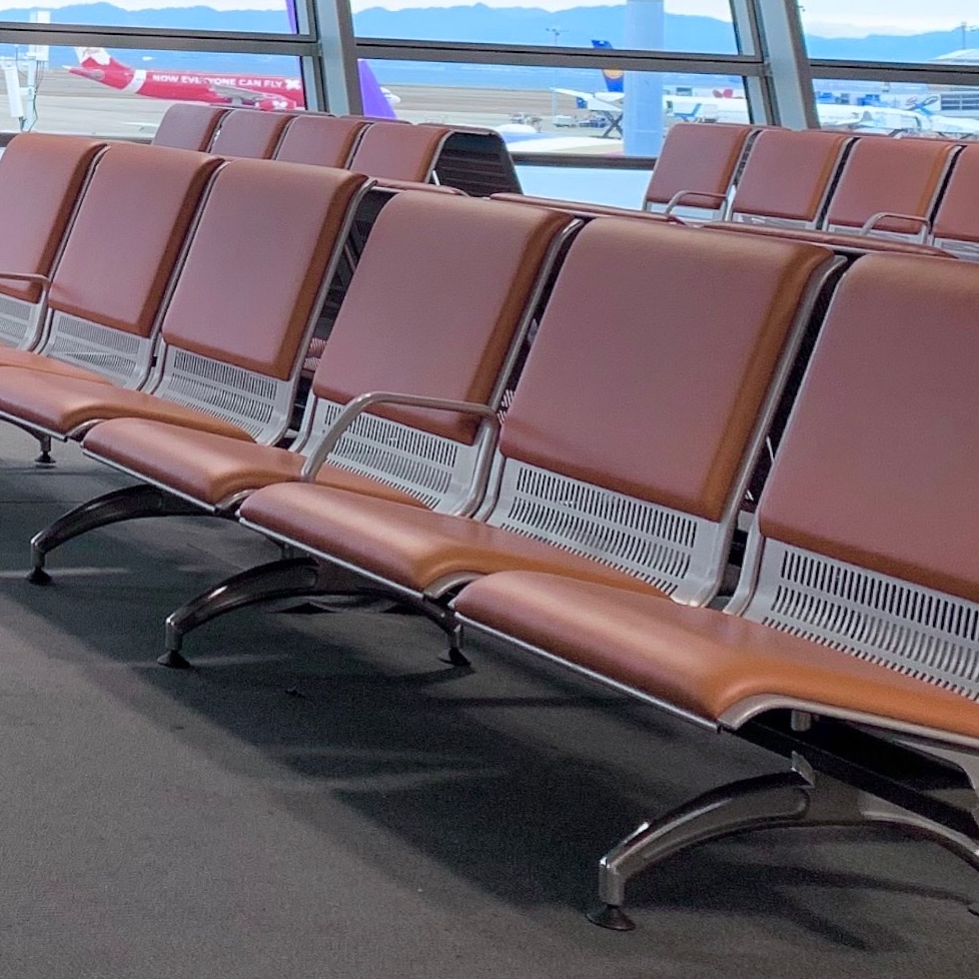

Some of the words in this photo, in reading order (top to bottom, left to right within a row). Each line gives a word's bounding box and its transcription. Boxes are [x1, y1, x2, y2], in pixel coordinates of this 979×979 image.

[152, 75, 180, 83] NOW
[180, 76, 237, 86] EVEYONE
[238, 79, 262, 87] CAN
[263, 80, 283, 89] FLY
